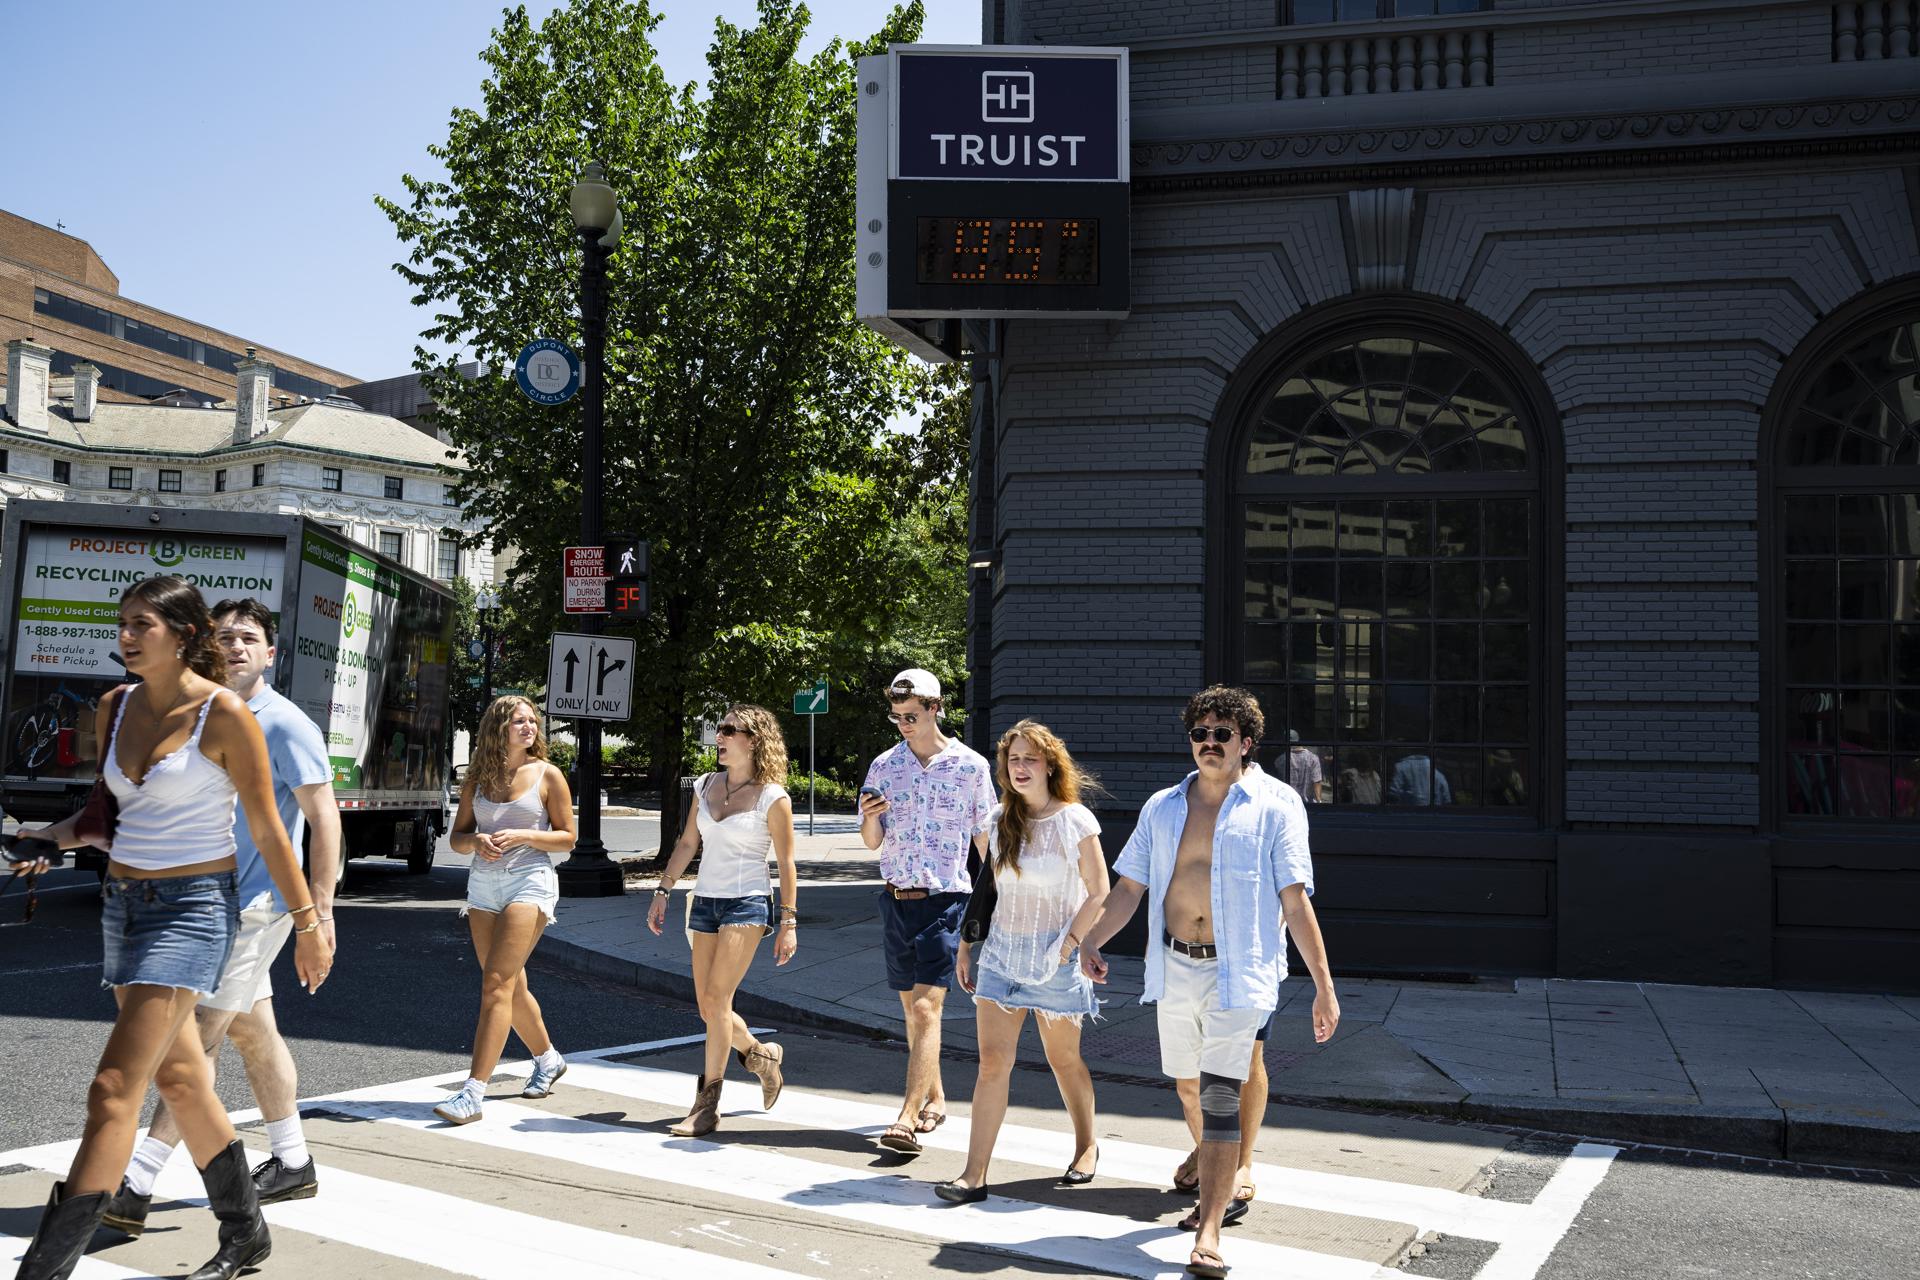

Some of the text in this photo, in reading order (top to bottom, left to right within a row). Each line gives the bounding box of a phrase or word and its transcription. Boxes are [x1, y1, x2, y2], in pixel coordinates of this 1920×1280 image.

[930, 133, 1086, 167] TRUIST
[529, 341, 570, 356] DUPONT
[529, 389, 567, 402] CIRCLE
[70, 537, 149, 555] PROJECT
[188, 544, 246, 561] GREEN
[575, 549, 603, 559] SNOW
[36, 565, 146, 583] RECYCLING
[573, 566, 604, 577] ROUTE
[568, 579, 579, 587] NO
[576, 588, 601, 596] DURING
[568, 597, 605, 606] EMERGENC
[27, 605, 120, 617] Gently Used Cloth
[313, 595, 343, 622] PROJECT
[356, 611, 376, 632] GREEN
[24, 625, 117, 640] 1-888-987-1305
[36, 643, 85, 655] Schedule
[298, 636, 381, 675] RECYCLING & DONATION
[30, 654, 99, 668] FREE Pickup
[555, 697, 584, 710] ONLY
[592, 699, 621, 712] ONLY
